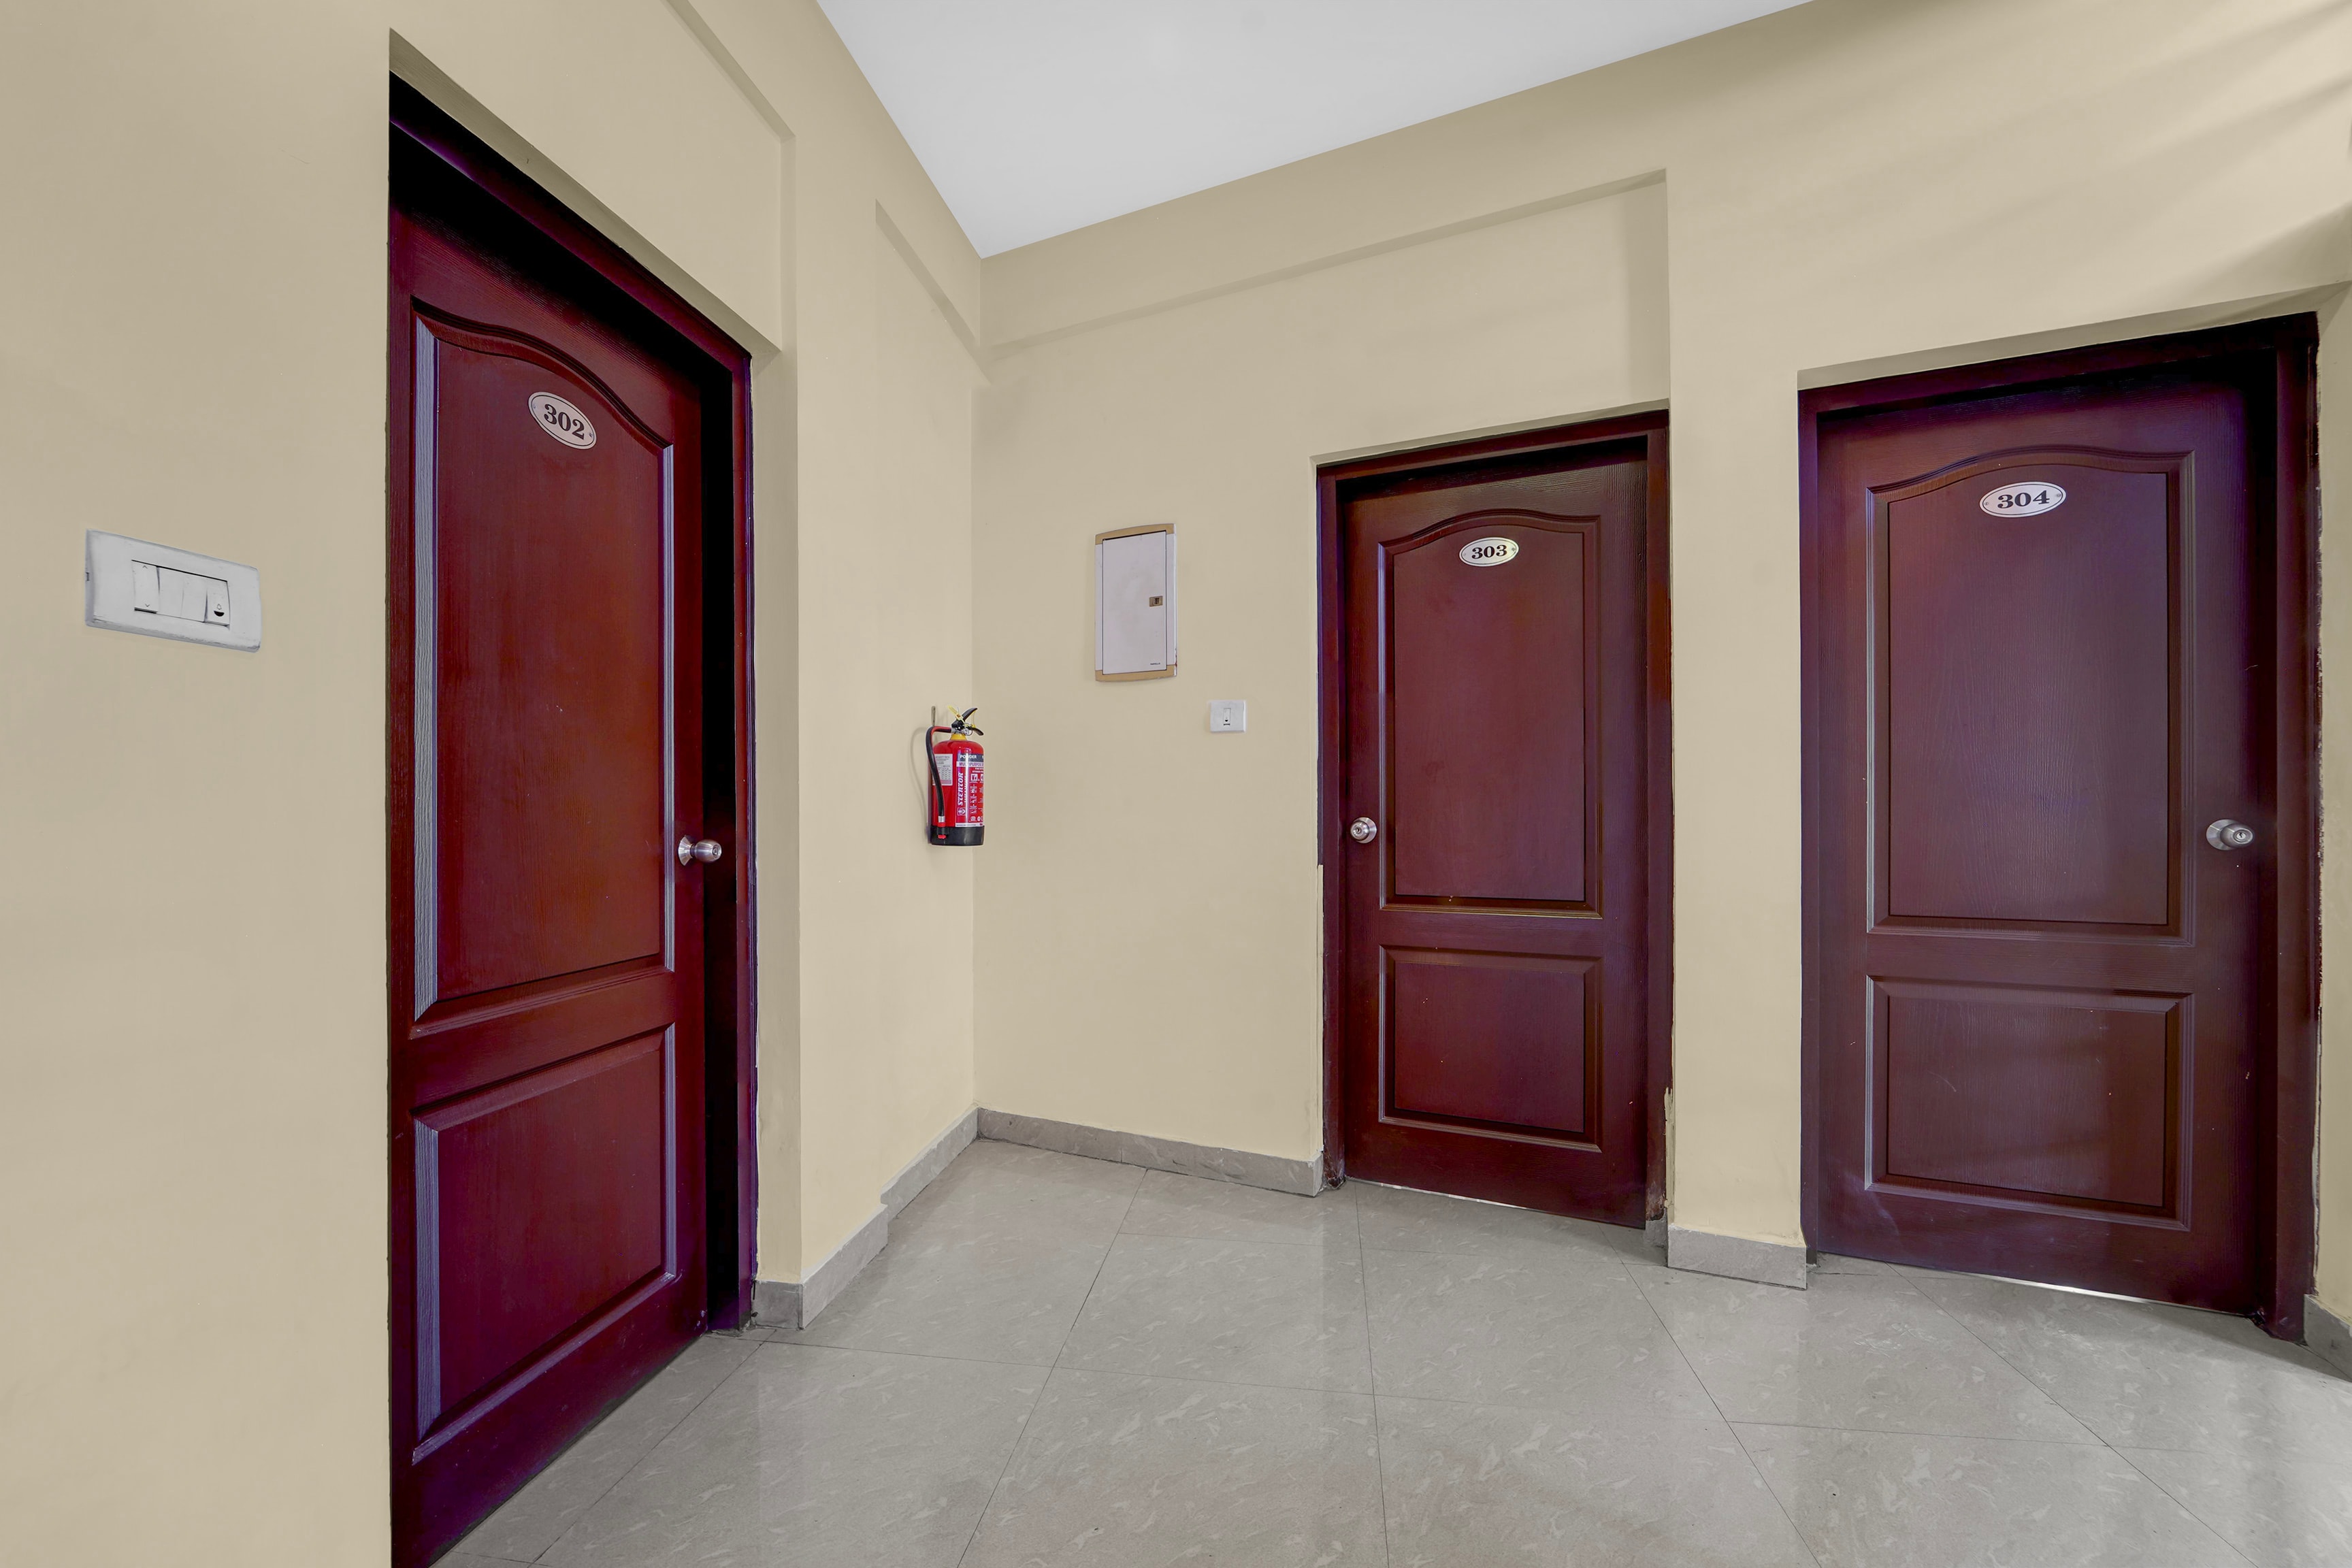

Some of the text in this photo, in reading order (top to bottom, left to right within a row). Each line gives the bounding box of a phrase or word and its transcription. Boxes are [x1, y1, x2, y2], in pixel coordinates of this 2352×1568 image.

[544, 404, 585, 440] 302
[1997, 490, 2050, 508] 304
[1472, 545, 1507, 559] 303
